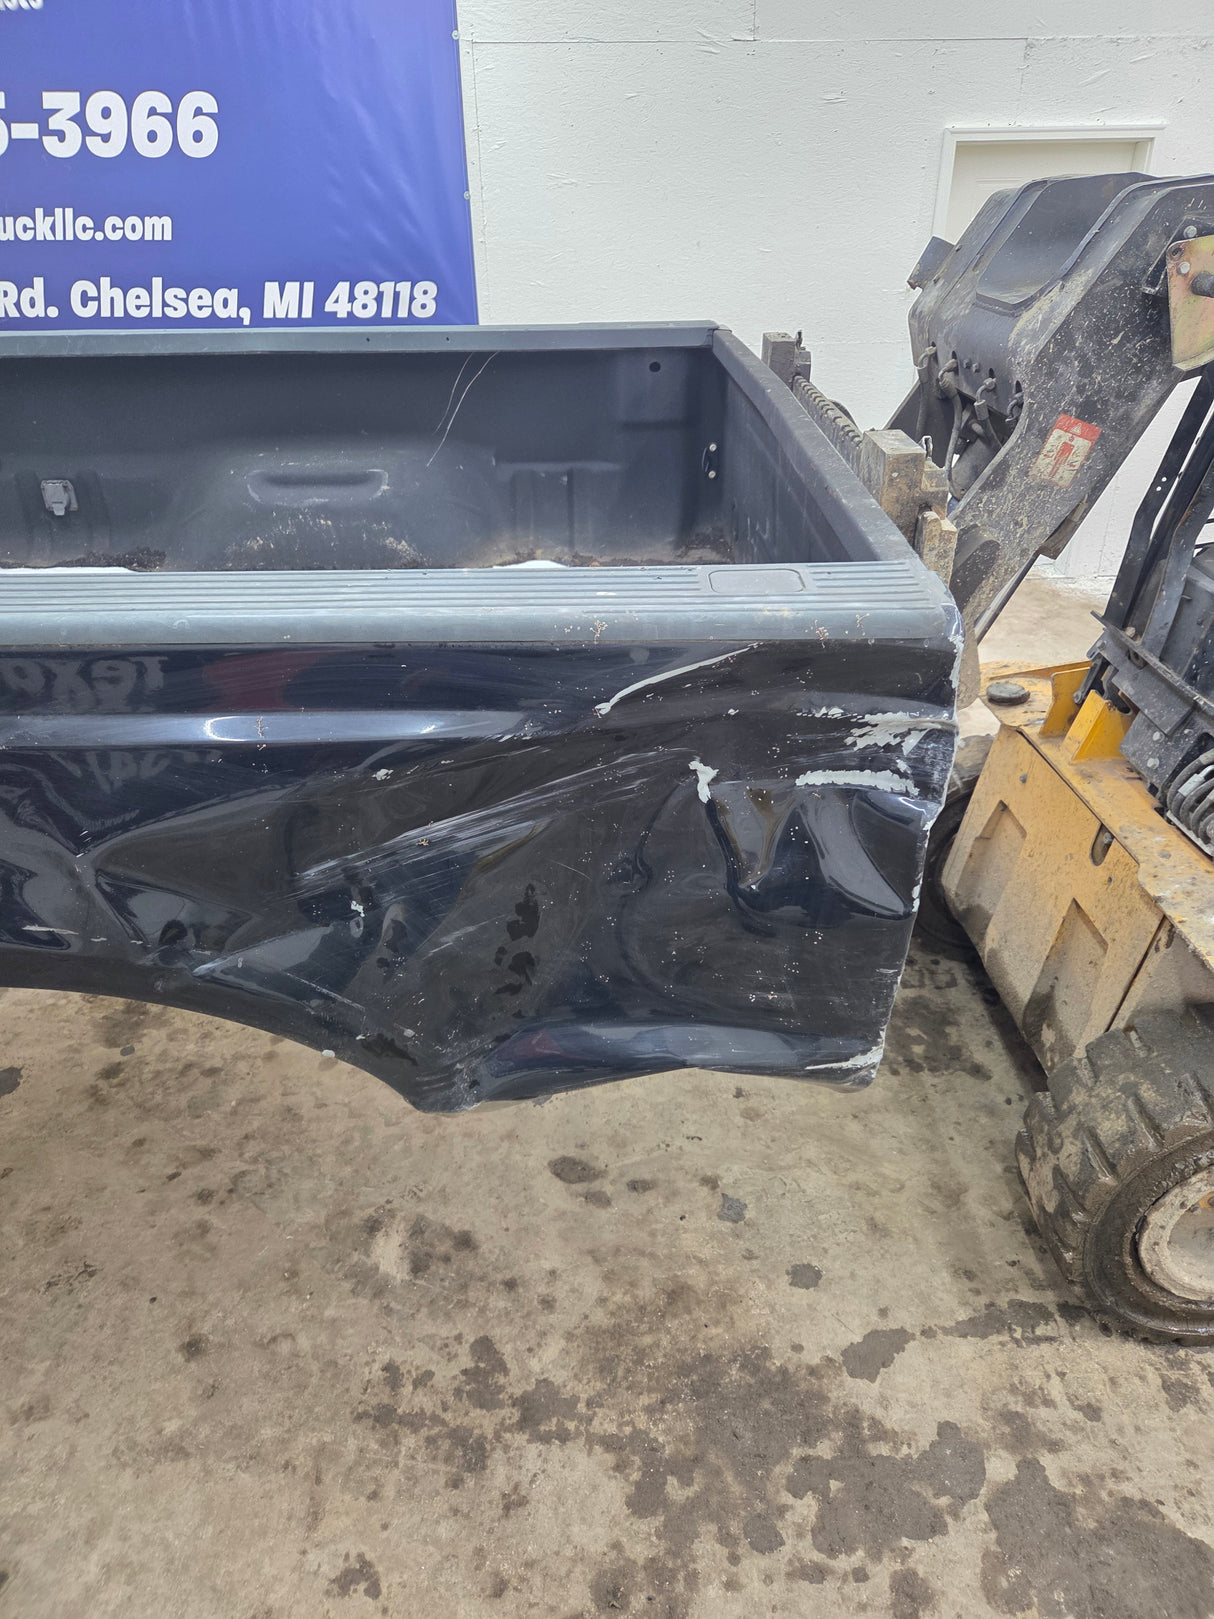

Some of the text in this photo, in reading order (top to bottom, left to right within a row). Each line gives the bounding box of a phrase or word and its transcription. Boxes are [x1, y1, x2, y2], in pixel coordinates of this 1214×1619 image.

[0, 91, 218, 158] -3966
[0, 277, 437, 325] Rd. Chelsea, MI 48118
